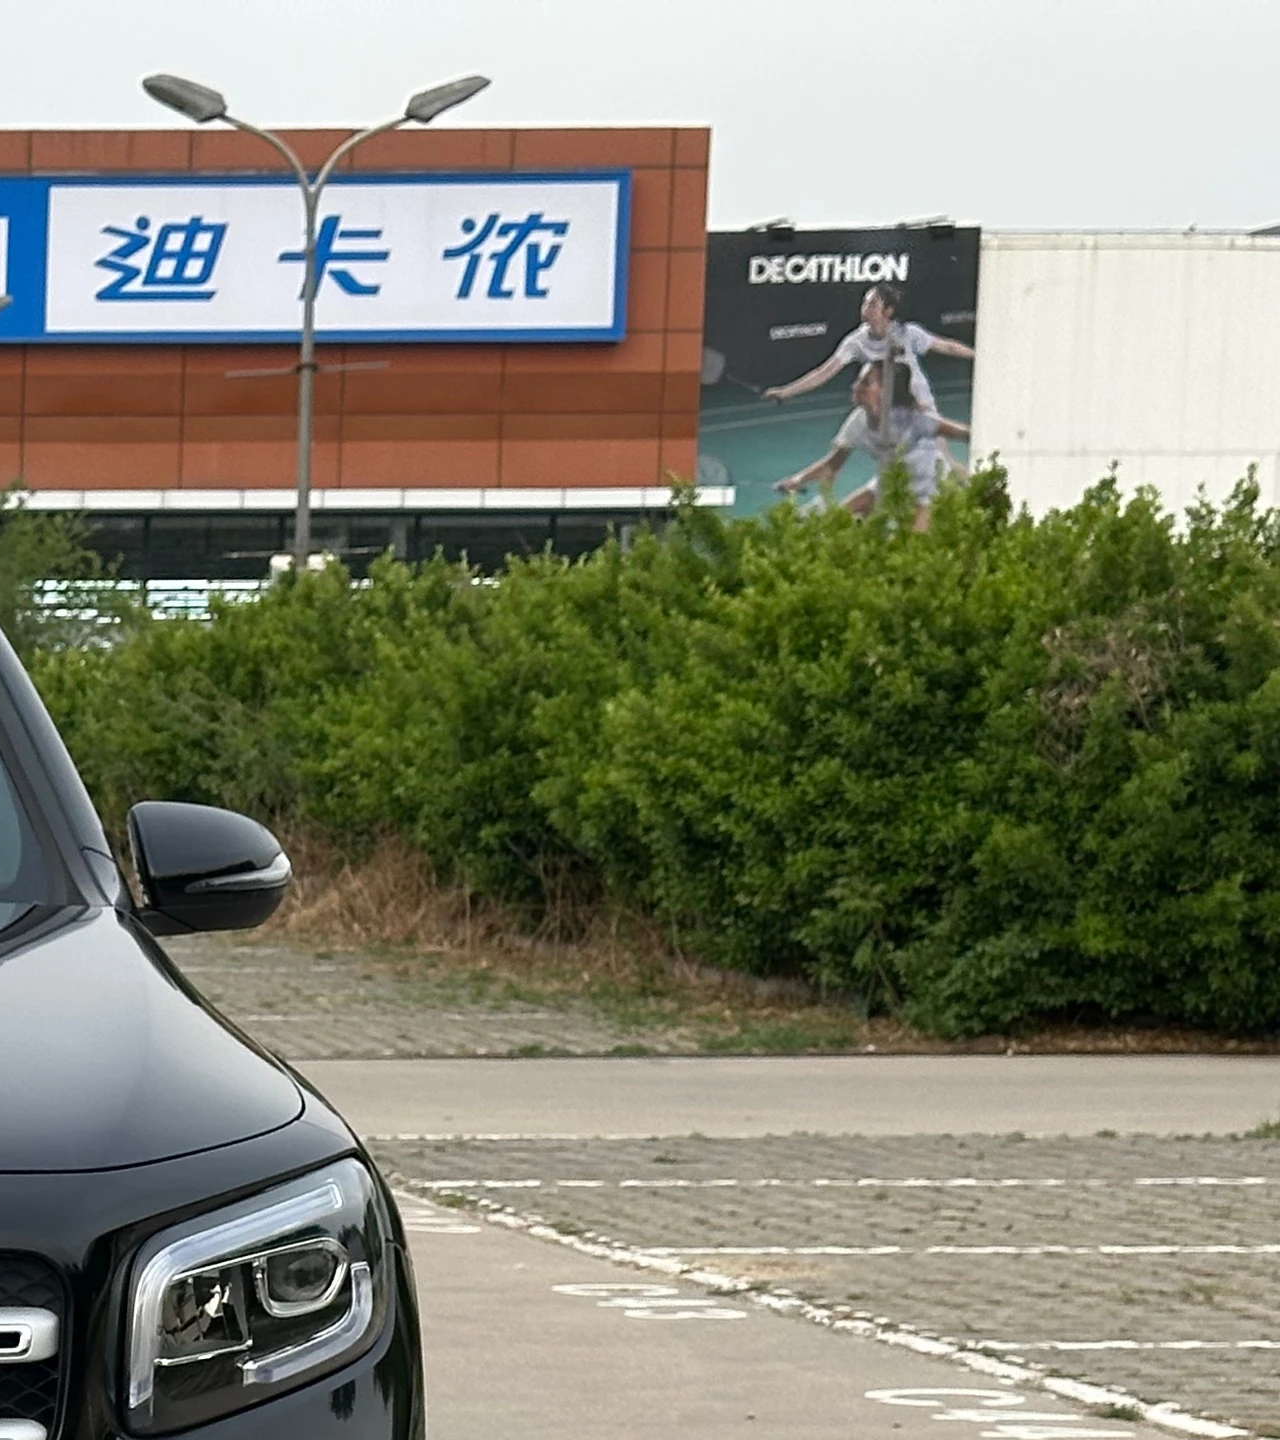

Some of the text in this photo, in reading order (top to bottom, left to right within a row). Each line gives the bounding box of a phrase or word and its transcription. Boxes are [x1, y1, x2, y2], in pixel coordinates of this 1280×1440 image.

[95, 212, 570, 301] 迪卡侬
[748, 253, 910, 285] DECATHLON
[864, 1387, 1137, 1440] C44
